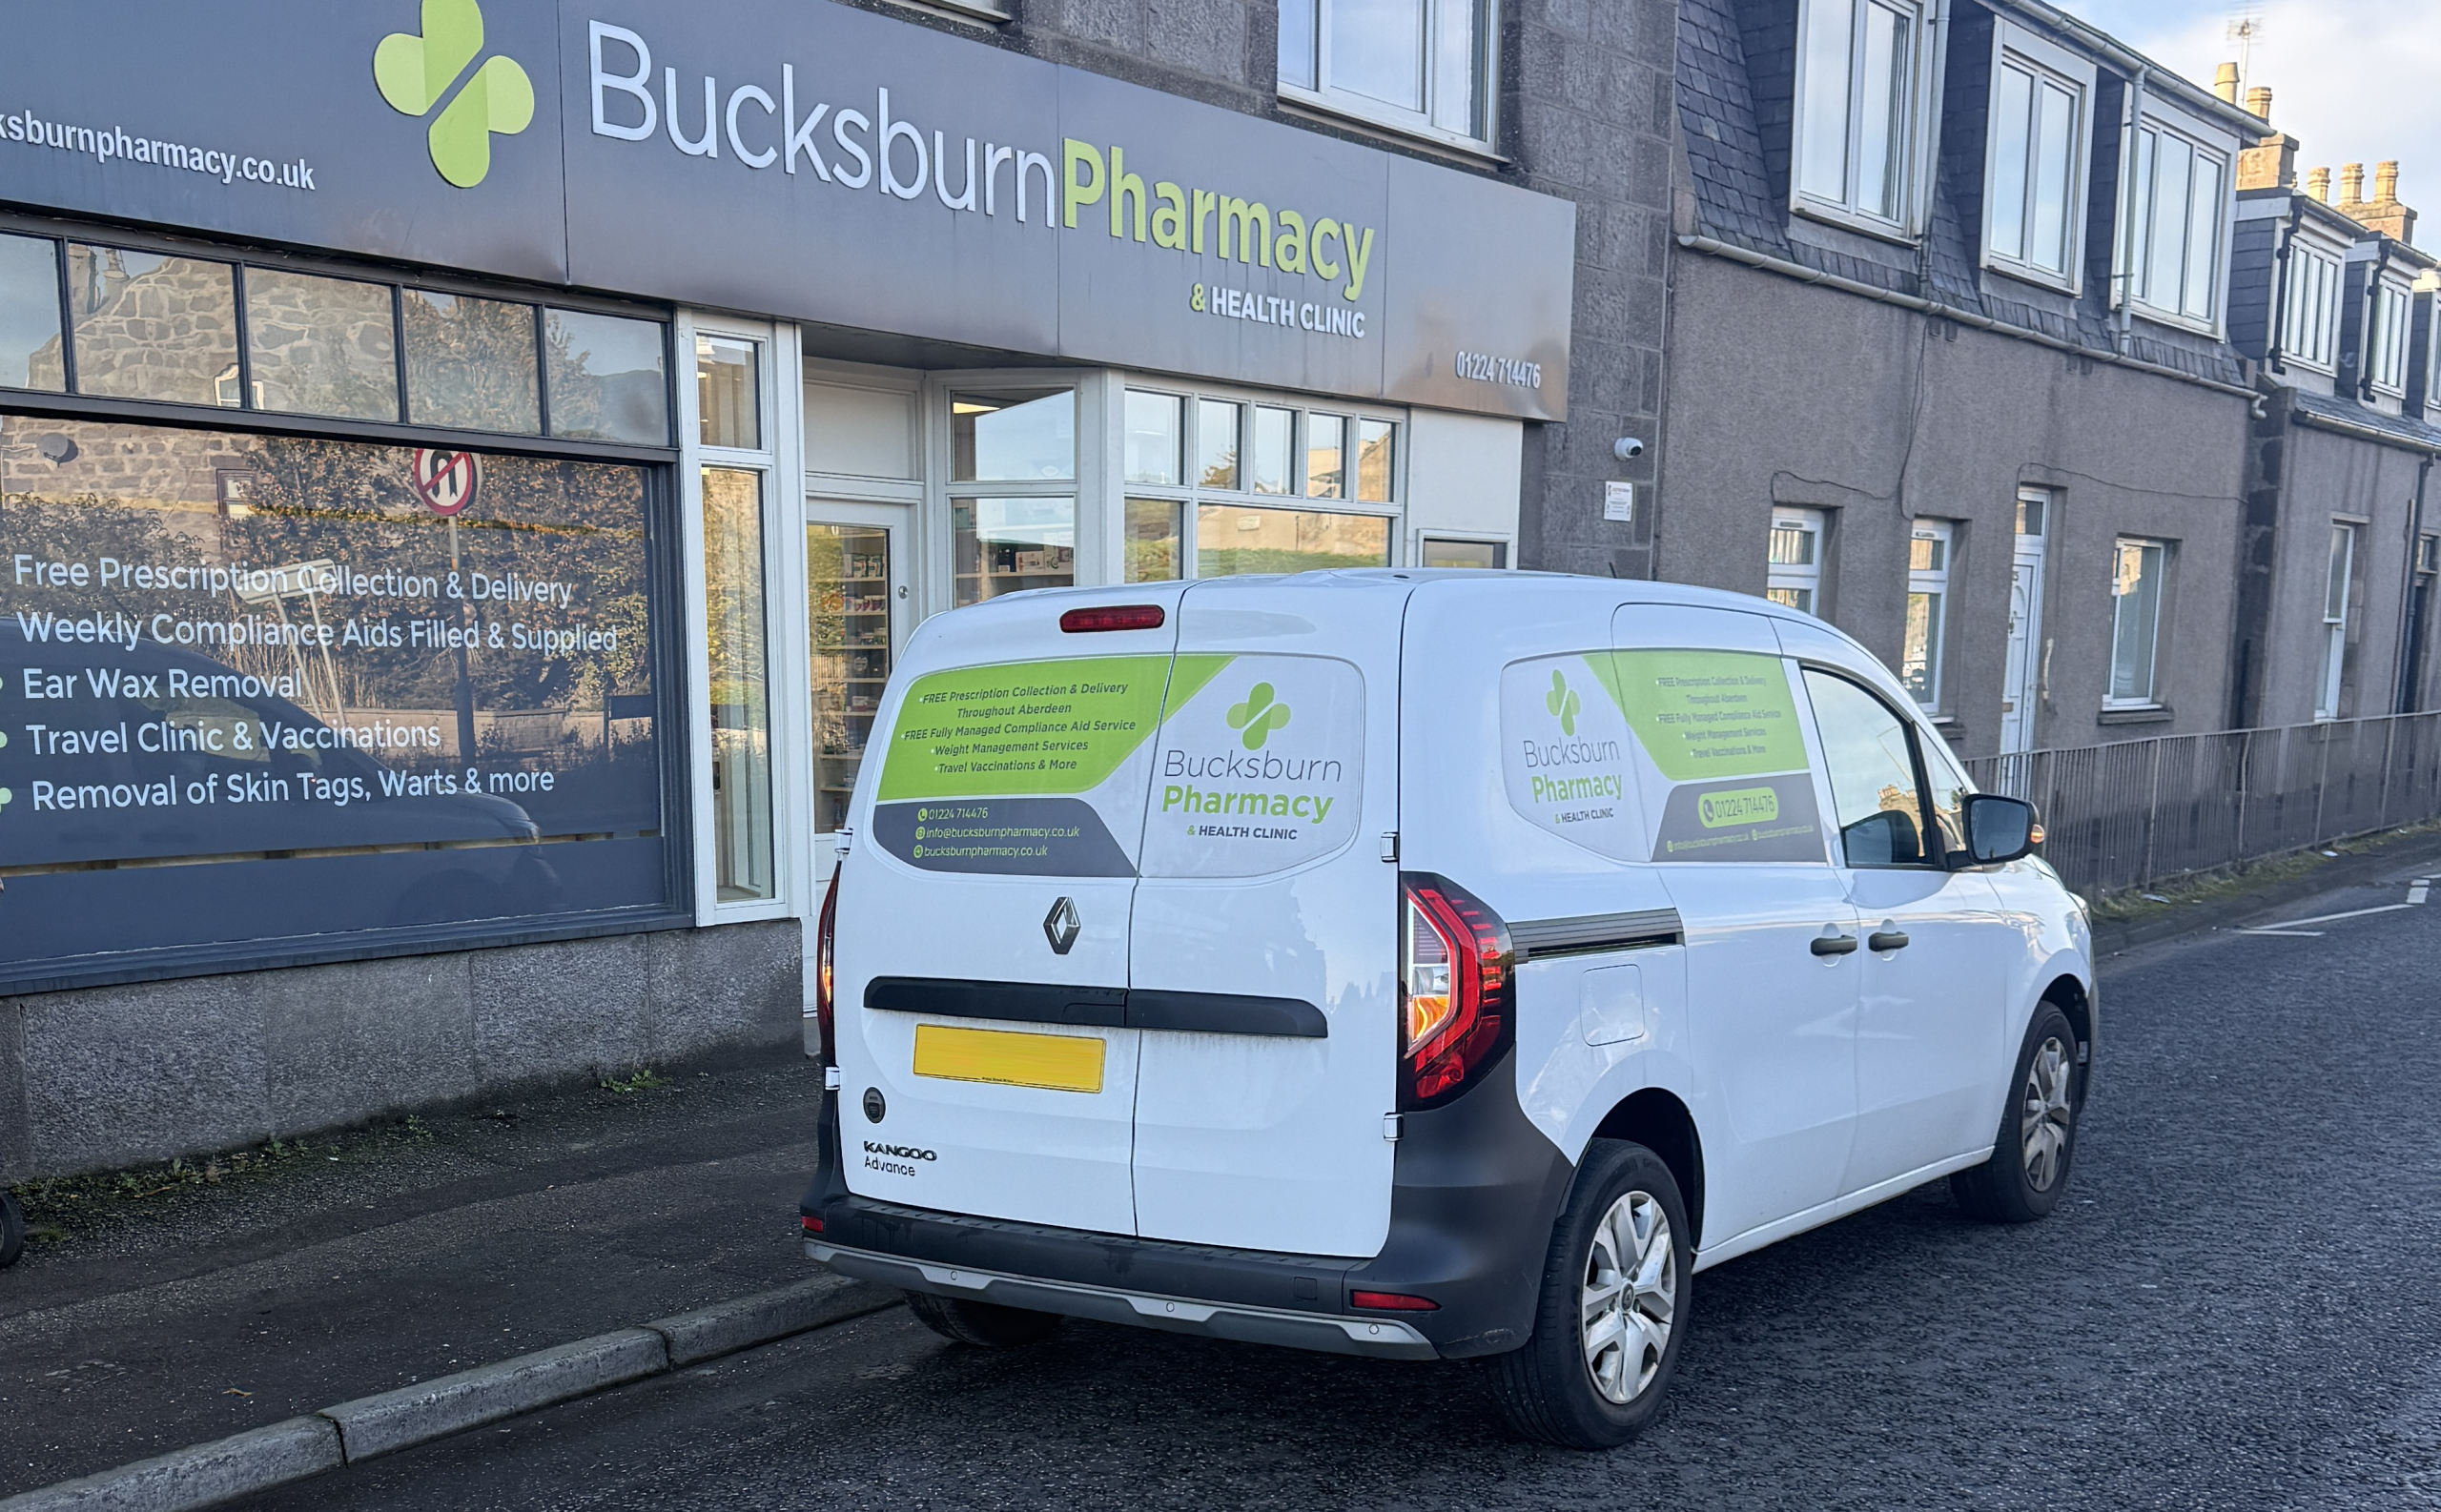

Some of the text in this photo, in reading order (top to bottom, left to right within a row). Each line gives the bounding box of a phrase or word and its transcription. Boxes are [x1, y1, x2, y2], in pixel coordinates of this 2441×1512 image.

[1191, 283, 1365, 338] & HEALTH CLINIC
[1456, 351, 1541, 389] 01224 714476
[13, 554, 572, 609] Free Prescription Collection & Delivery
[16, 611, 617, 656] Weekly Compliance Aids Filled & Supplied
[23, 668, 302, 699] Ear Wax Removal
[923, 683, 1128, 704] FREE Prescription Collection & Delivery
[957, 704, 1072, 719] Throughout Aberdeen
[25, 719, 441, 755] Travel Clinic & Vaccinations
[904, 720, 1136, 741] FREE Fully Managed Compliance Aid Service
[934, 740, 1089, 757] Weight Management Services
[1523, 736, 1620, 767] Bucksburn
[938, 759, 1077, 773] Travel Vaccinations & More
[1164, 749, 1342, 782] Bucksburn
[32, 767, 554, 810] Removal of Skin Tags, Warts & more
[1531, 773, 1622, 804] Pharmacy
[929, 807, 988, 820] 01224 714476
[1161, 785, 1334, 824] Pharmacy
[1561, 809, 1590, 824] HEALTH
[1590, 807, 1614, 820] CLINIC
[1714, 795, 1774, 819] 01224 714476
[926, 826, 1079, 840] info@bucksburnpharmacy.co.uk
[1187, 825, 1298, 840] & HEALTH CLINIC
[924, 845, 1048, 858] bucksburnpharmacy.co.uk
[864, 1140, 937, 1162] KANGOO
[864, 1155, 915, 1176] Advance
